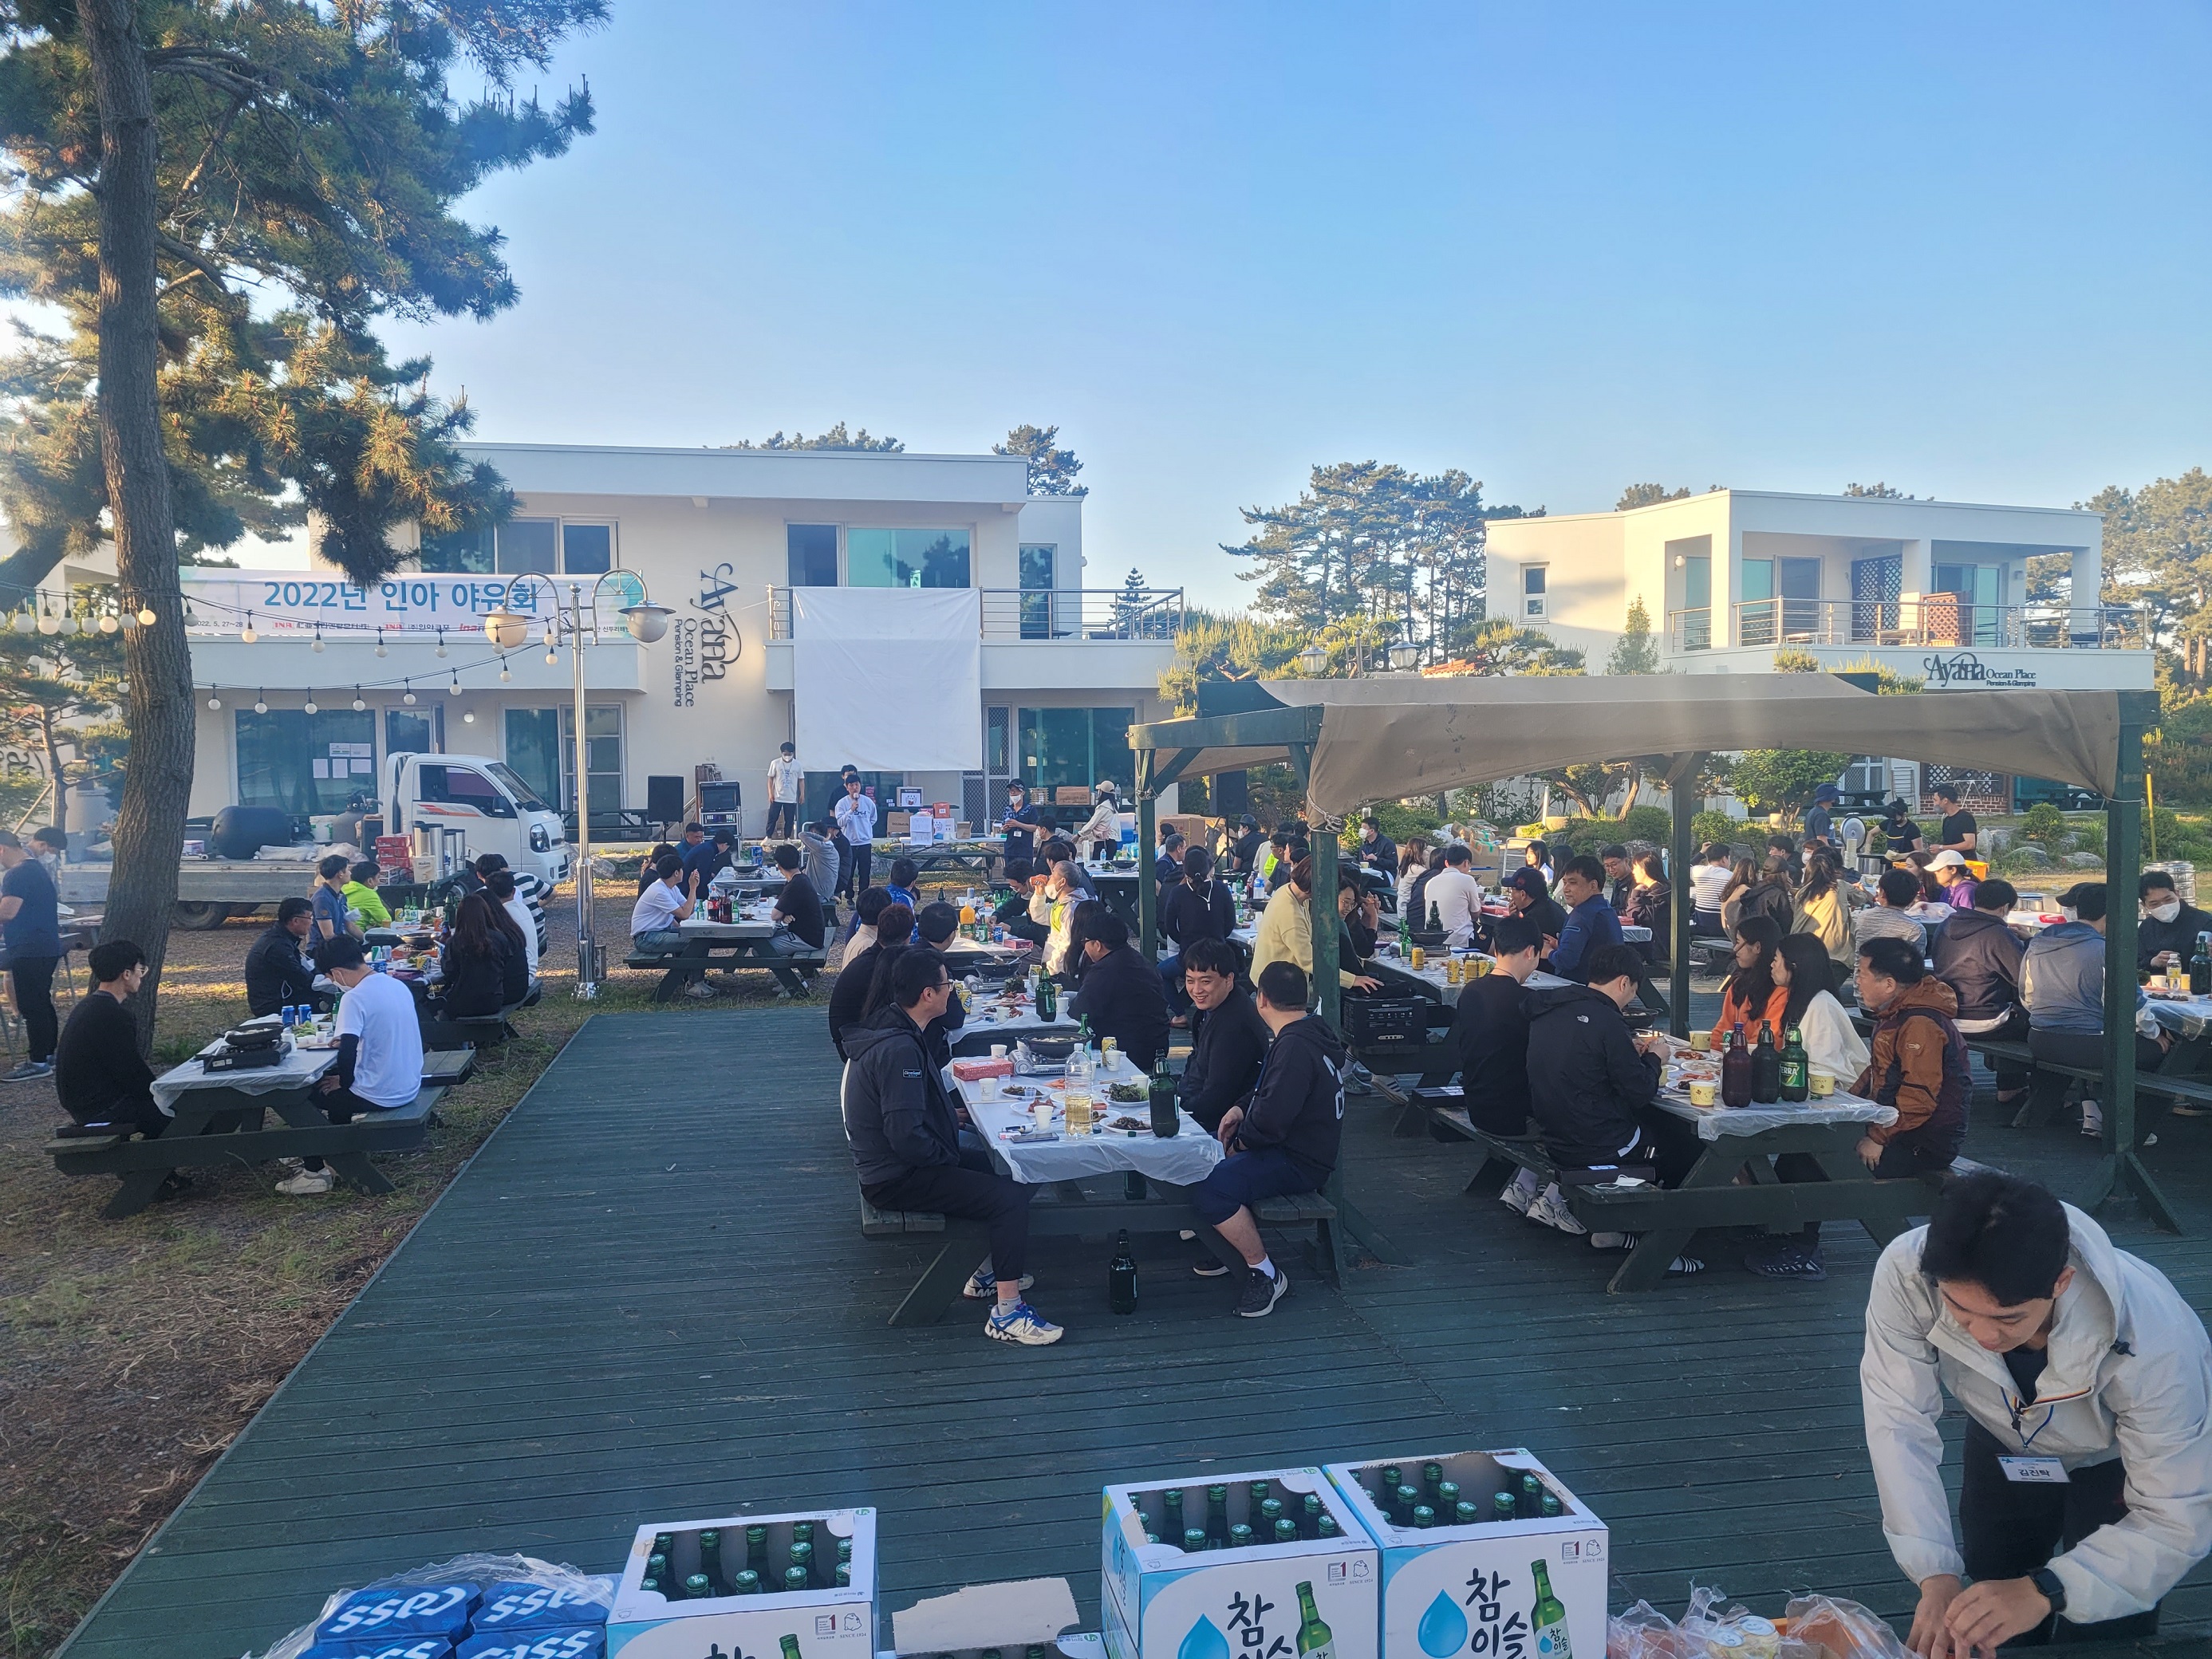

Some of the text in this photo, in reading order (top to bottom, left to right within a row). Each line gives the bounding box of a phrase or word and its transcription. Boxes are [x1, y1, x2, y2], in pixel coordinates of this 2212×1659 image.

[264, 581, 538, 613] 2022년 인아 야유회
[674, 618, 683, 654] Pension
[689, 562, 742, 684] Ayana
[684, 617, 698, 707] Ocean Place
[1923, 652, 2037, 688] Ayana Ocean Place
[674, 664, 684, 707] Glamping
[2017, 1468, 2051, 1477] 김진탁
[1465, 1567, 1511, 1622] 참
[1227, 1590, 1275, 1647] 참
[1550, 1627, 1562, 1642] 참
[1553, 1637, 1569, 1652] 이슬
